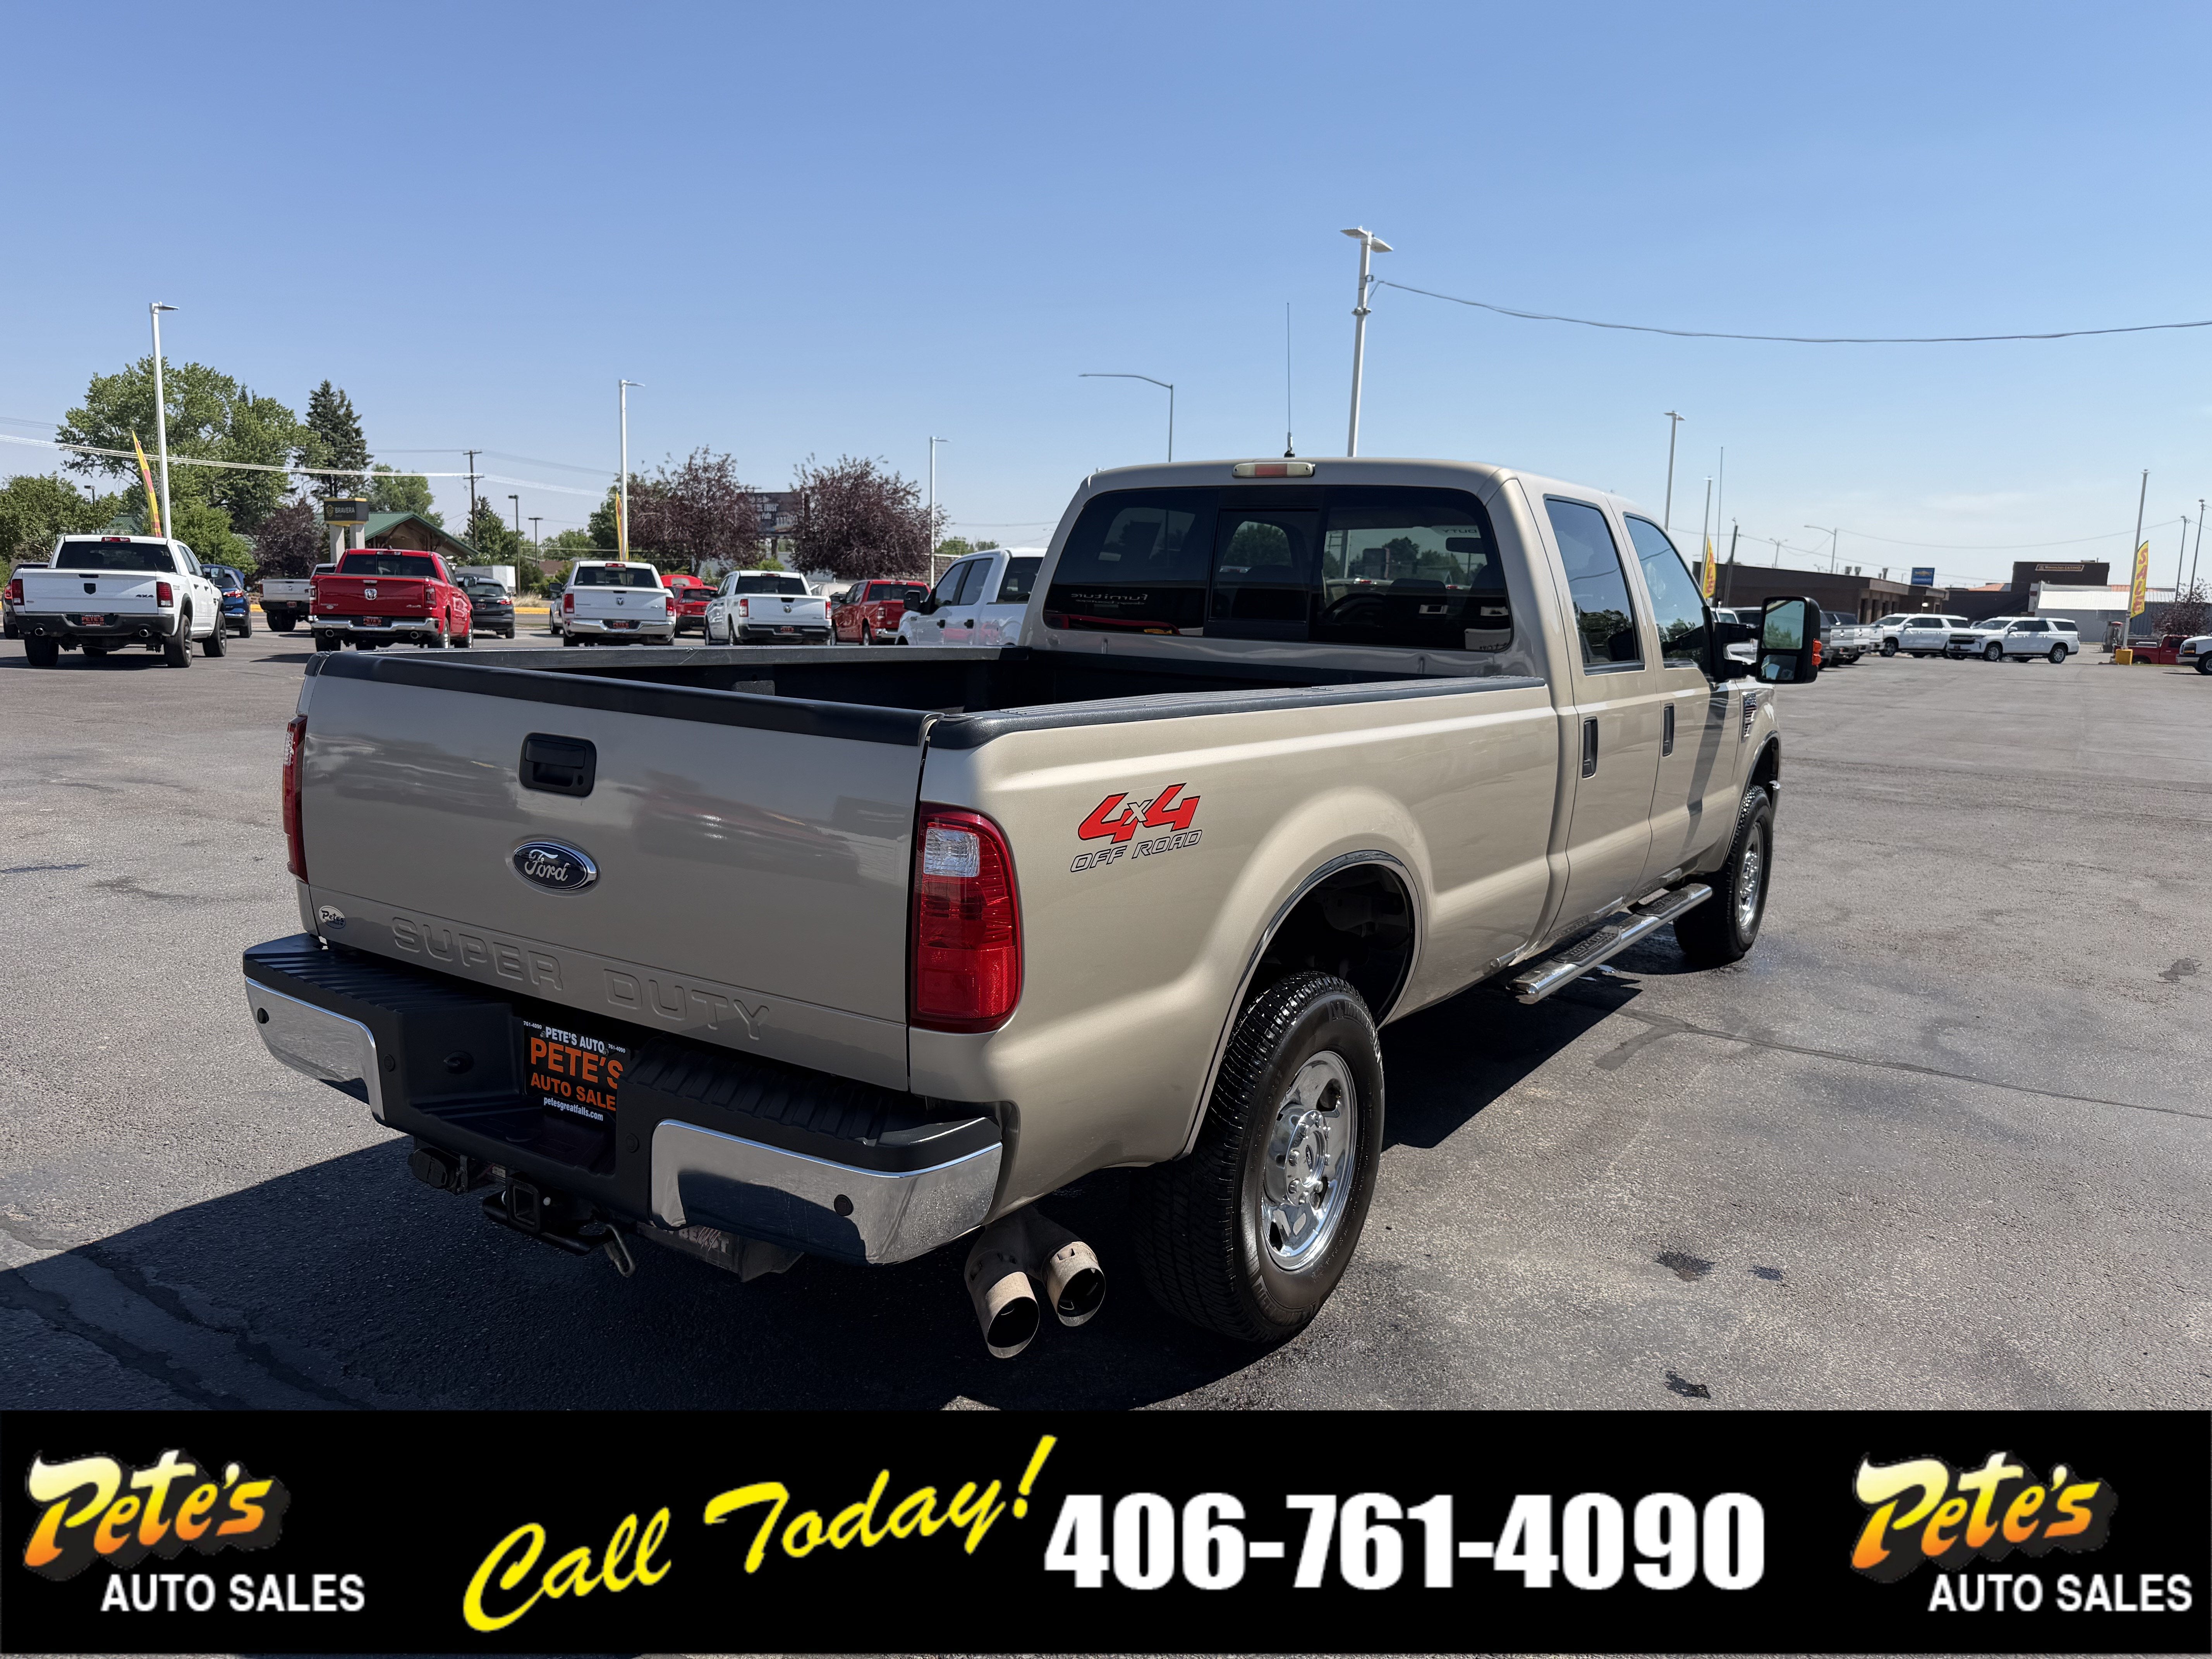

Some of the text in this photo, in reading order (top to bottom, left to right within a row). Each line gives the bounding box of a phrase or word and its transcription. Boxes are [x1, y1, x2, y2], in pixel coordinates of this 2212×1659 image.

[2133, 548, 2148, 613] SALE
[524, 849, 571, 881] Ford
[1070, 829, 1202, 872] OFF ROAD
[392, 917, 769, 1041] SUPER DUTY
[523, 1020, 542, 1030] 761-4090
[545, 1026, 605, 1054] PETE'S AUTO
[531, 1037, 623, 1089] PETE'S
[608, 1043, 626, 1053] 761-4090
[531, 1072, 616, 1111] AUTO SALE
[544, 1097, 603, 1121] petesgreatfalls.com
